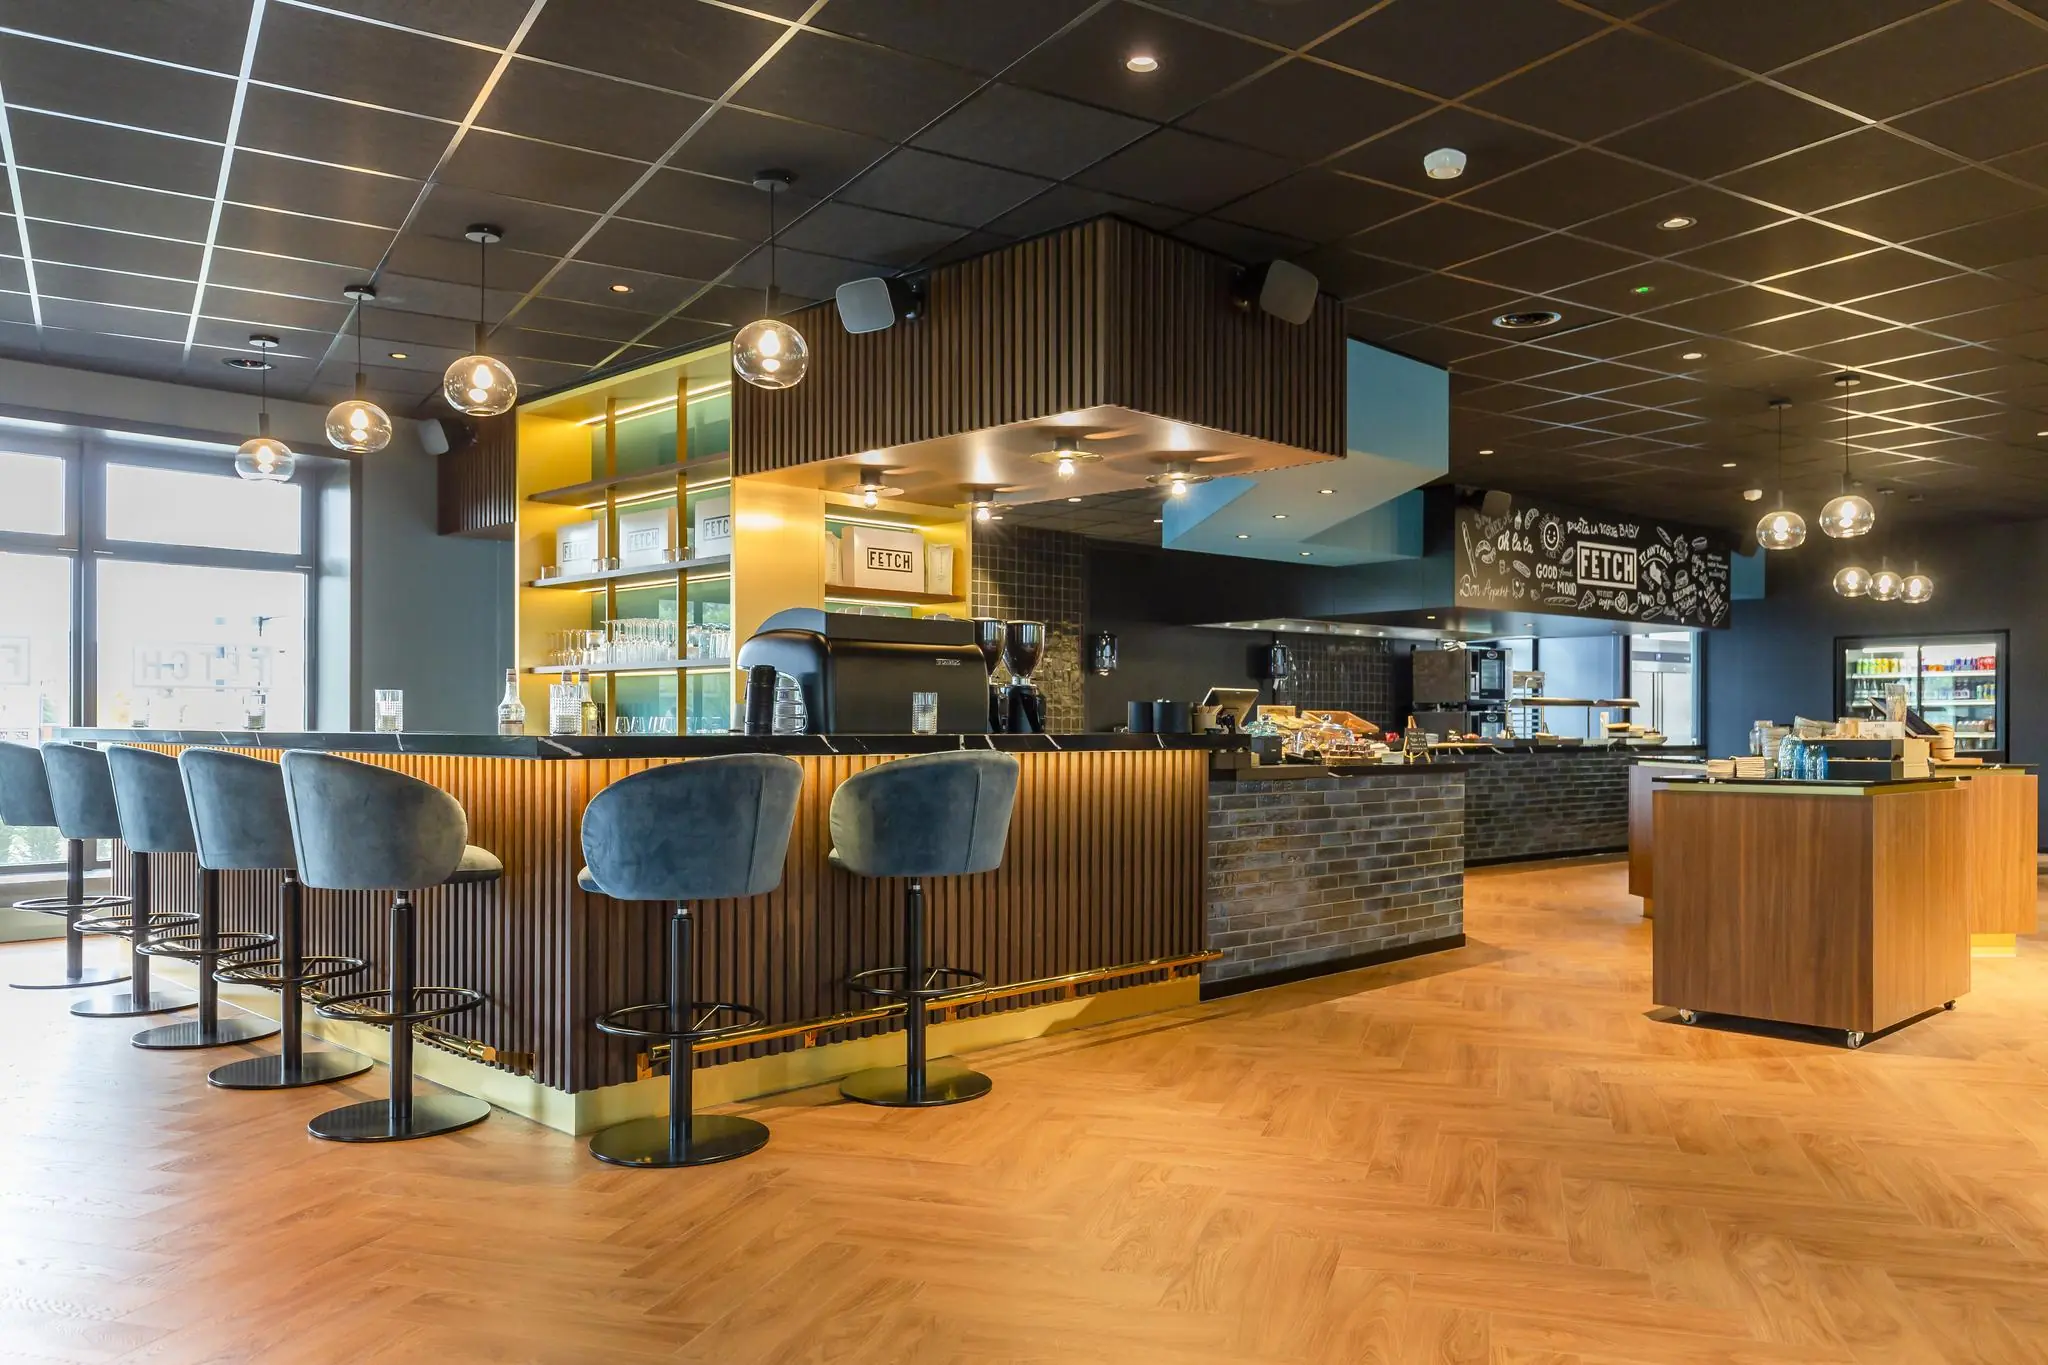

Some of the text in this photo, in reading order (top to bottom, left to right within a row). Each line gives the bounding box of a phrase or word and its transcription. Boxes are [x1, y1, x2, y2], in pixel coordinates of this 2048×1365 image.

[705, 519, 730, 537] FETC
[1619, 524, 1639, 538] BABY
[870, 551, 911, 569] FETCH
[1581, 548, 1634, 583] FETCH
[1536, 563, 1558, 579] GOOD
[1459, 574, 1480, 597] Bon
[1557, 581, 1577, 596] MOOD
